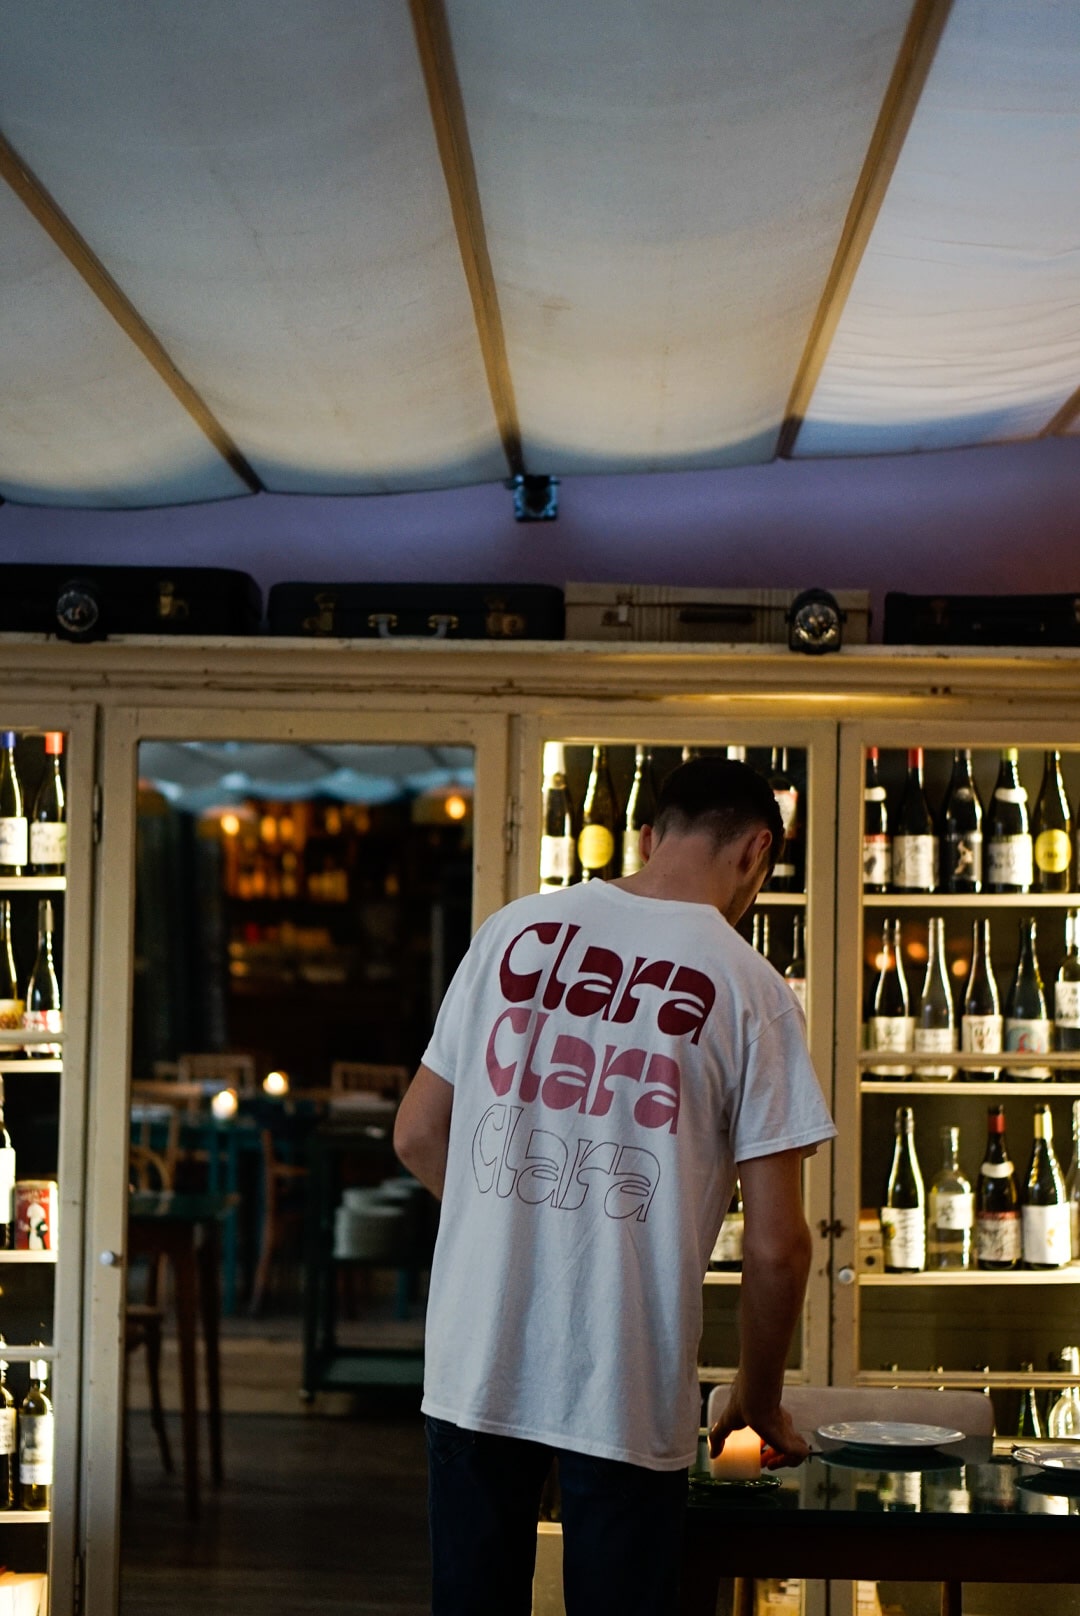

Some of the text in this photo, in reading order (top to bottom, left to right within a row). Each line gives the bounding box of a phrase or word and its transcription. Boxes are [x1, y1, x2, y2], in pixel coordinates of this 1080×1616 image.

[499, 922, 716, 1045] Clara
[485, 1007, 681, 1135] Clara
[471, 1103, 661, 1222] Clara
